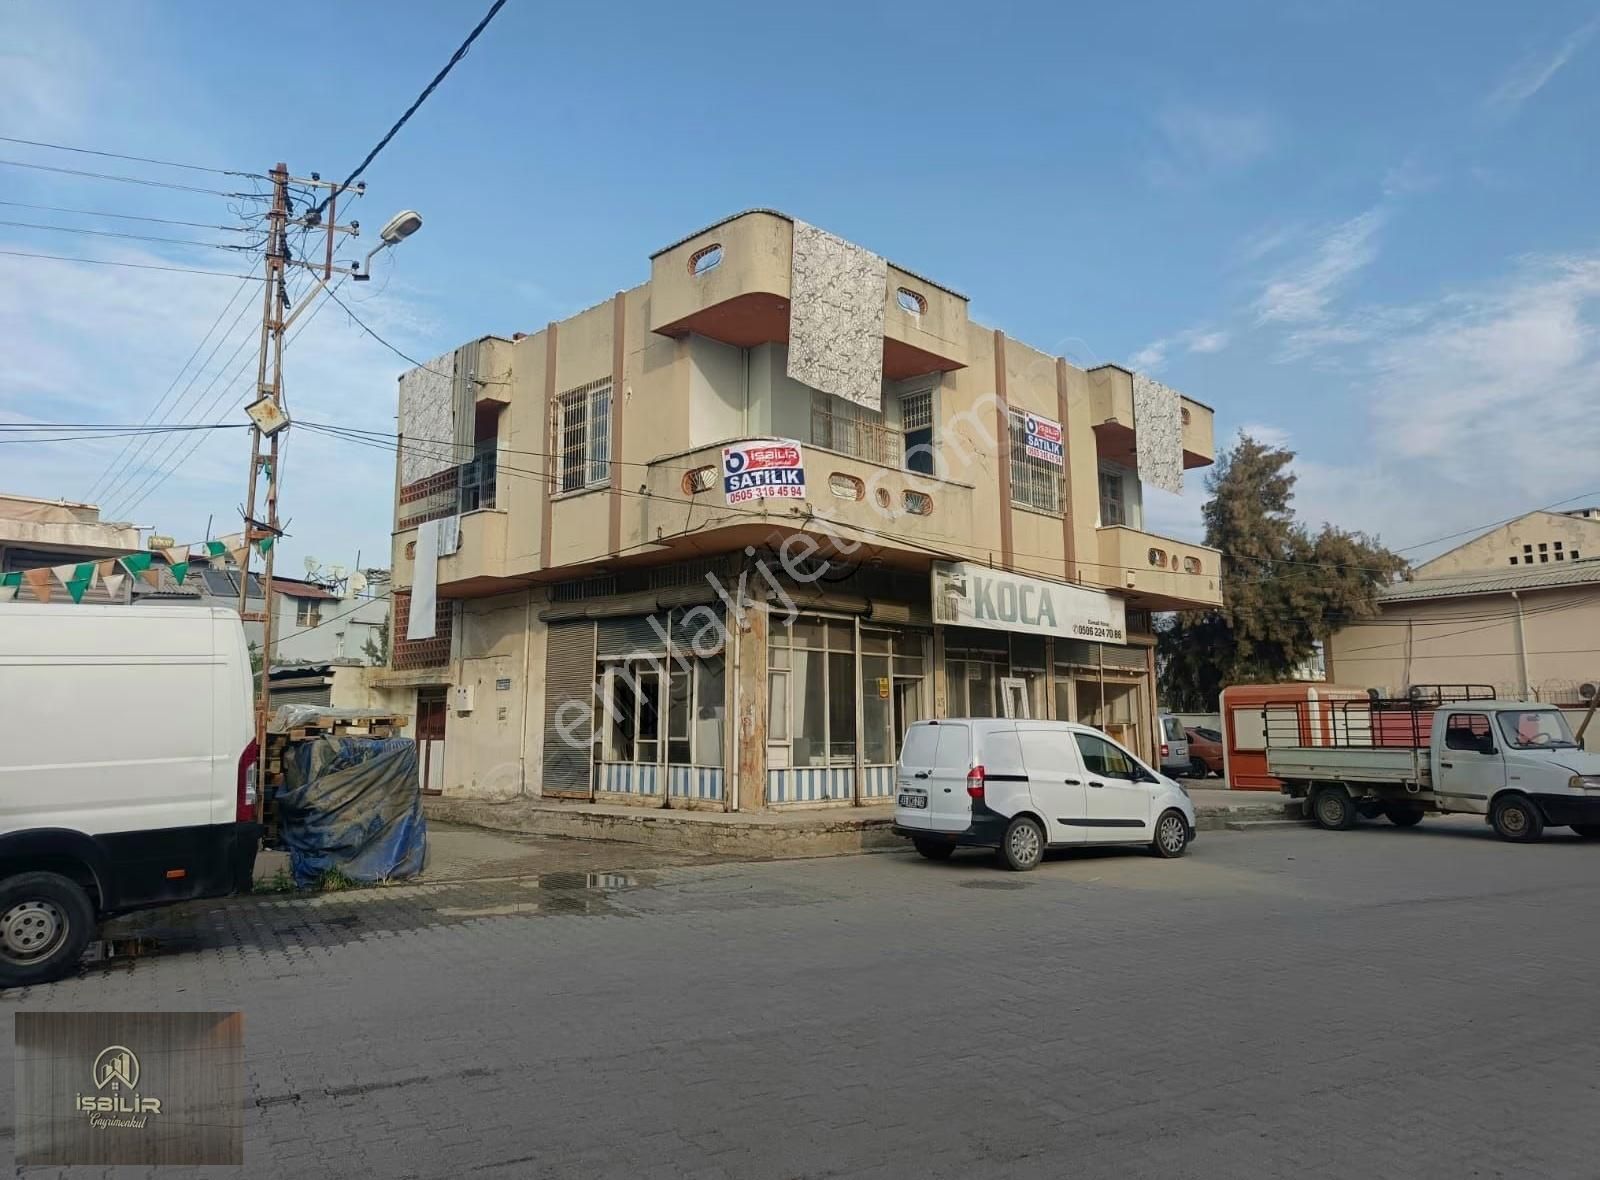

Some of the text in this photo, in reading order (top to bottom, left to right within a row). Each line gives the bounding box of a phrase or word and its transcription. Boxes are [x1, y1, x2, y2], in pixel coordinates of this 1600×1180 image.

[1028, 434, 1060, 455] SATILIK
[730, 470, 799, 490] SATILIK
[730, 486, 802, 503] 0505 316 45 94
[973, 576, 1057, 627] KOCA
[1094, 627, 1105, 638] 224
[1106, 629, 1114, 639] 70
